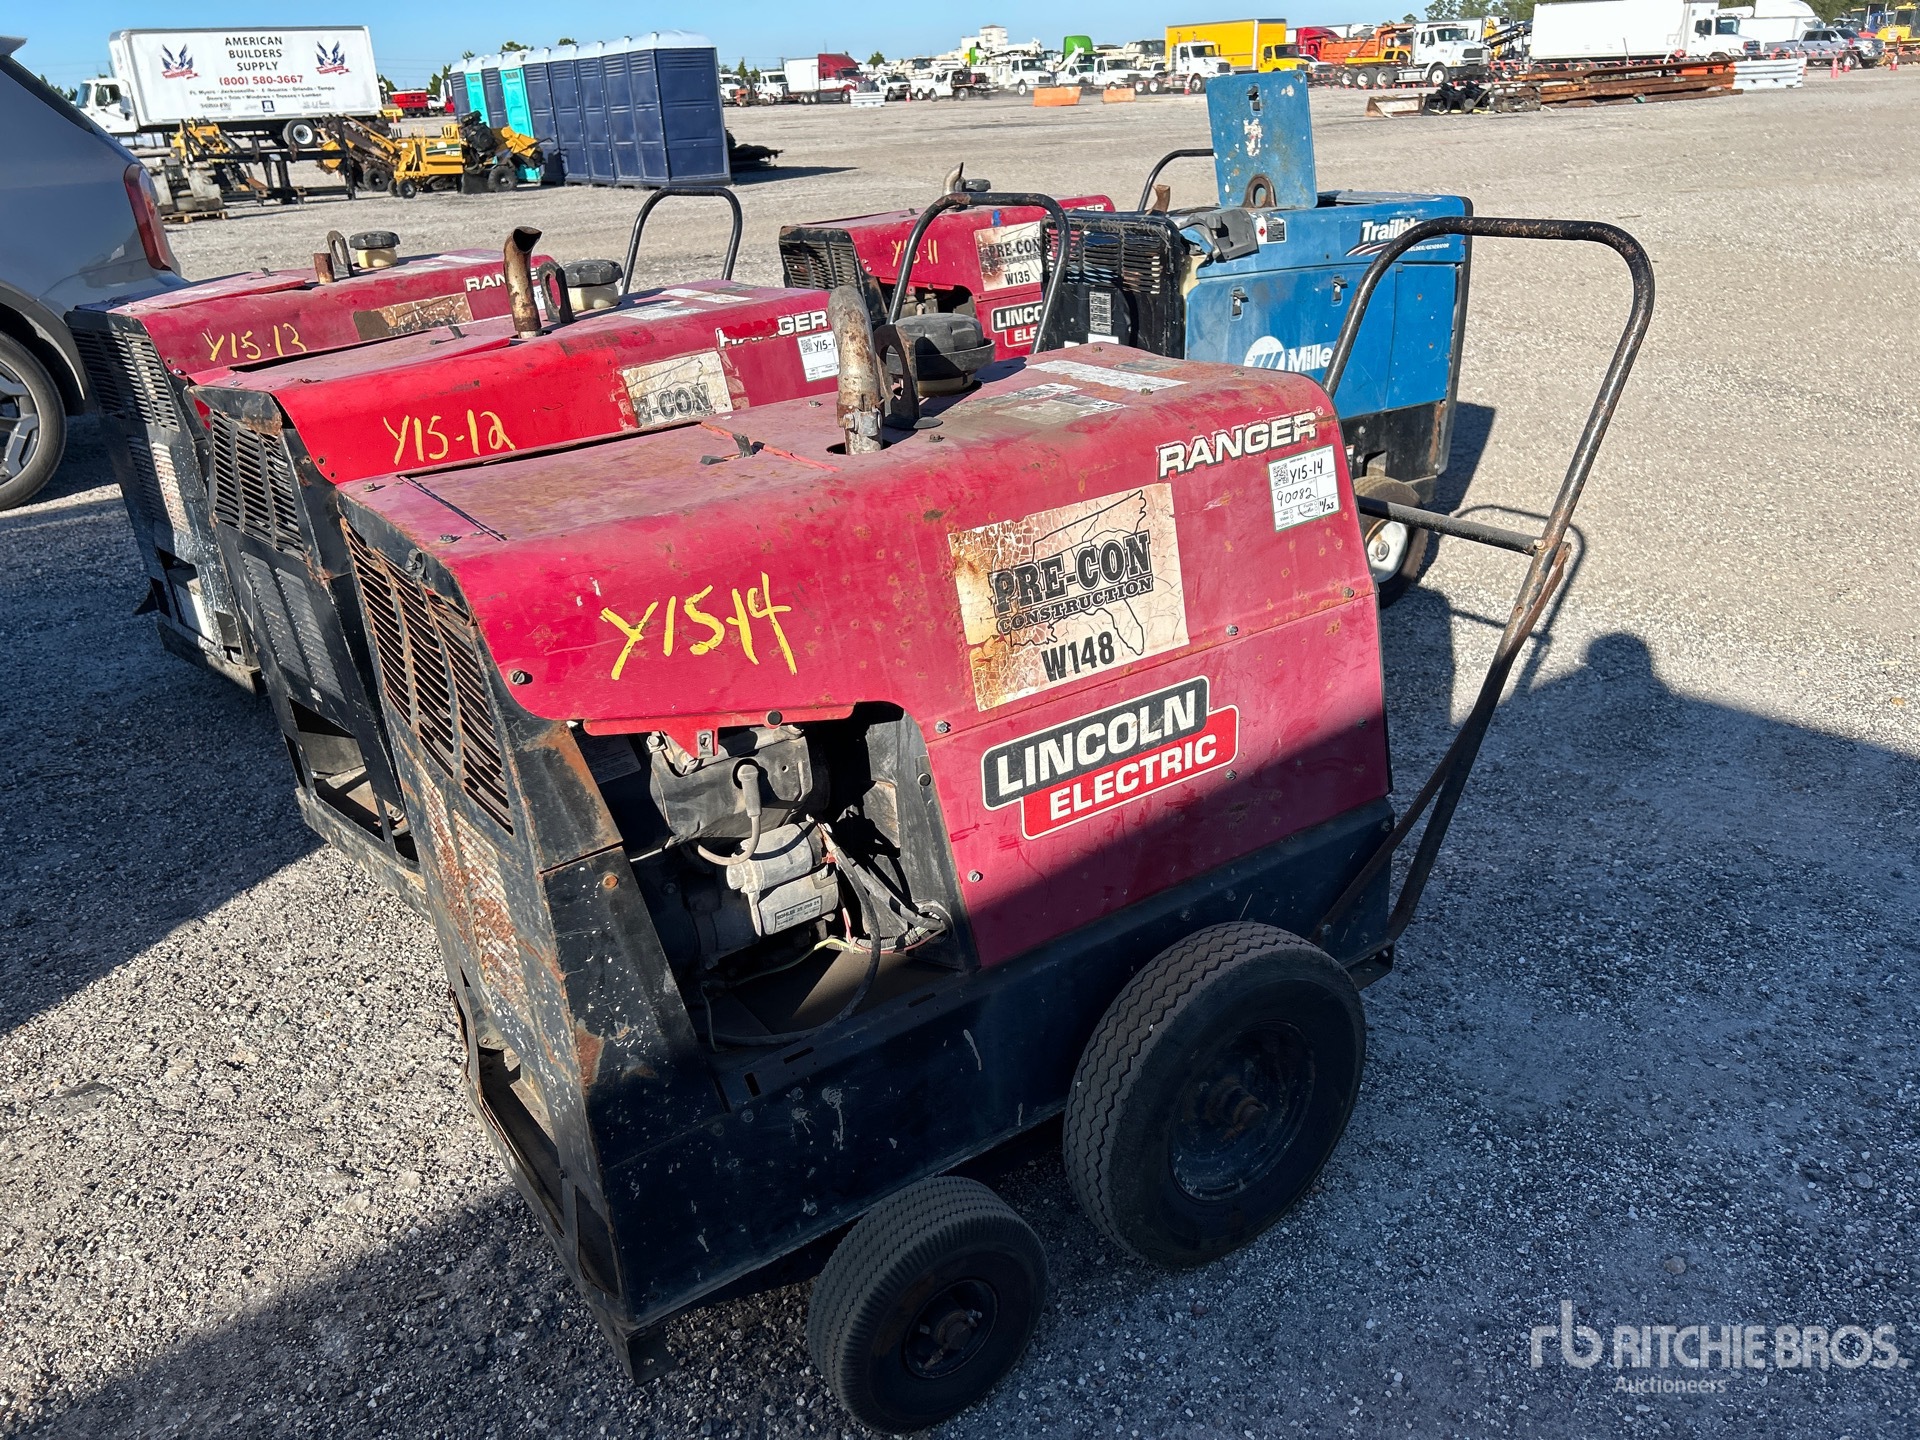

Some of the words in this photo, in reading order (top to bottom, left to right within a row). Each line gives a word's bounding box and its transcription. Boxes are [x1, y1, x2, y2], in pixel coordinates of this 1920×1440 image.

[225, 36, 283, 46] AMERICAN
[228, 48, 283, 59] BUILDERS
[219, 76, 249, 86] (800)
[252, 74, 304, 85] 580-3667
[236, 61, 279, 71] SUPPLY
[1005, 270, 1031, 286] W135
[1287, 343, 1334, 373] Mille
[383, 408, 518, 467] Y15-12
[1157, 411, 1318, 480] RANGER
[1289, 457, 1324, 484] Y15-14
[1276, 487, 1317, 507] 90082
[988, 530, 1152, 617] PRE-CON
[996, 575, 1154, 635] CONSTRUCTION
[1041, 631, 1116, 682] W148
[997, 689, 1196, 797] LINCOLN
[1050, 733, 1217, 821] ELECTRIC
